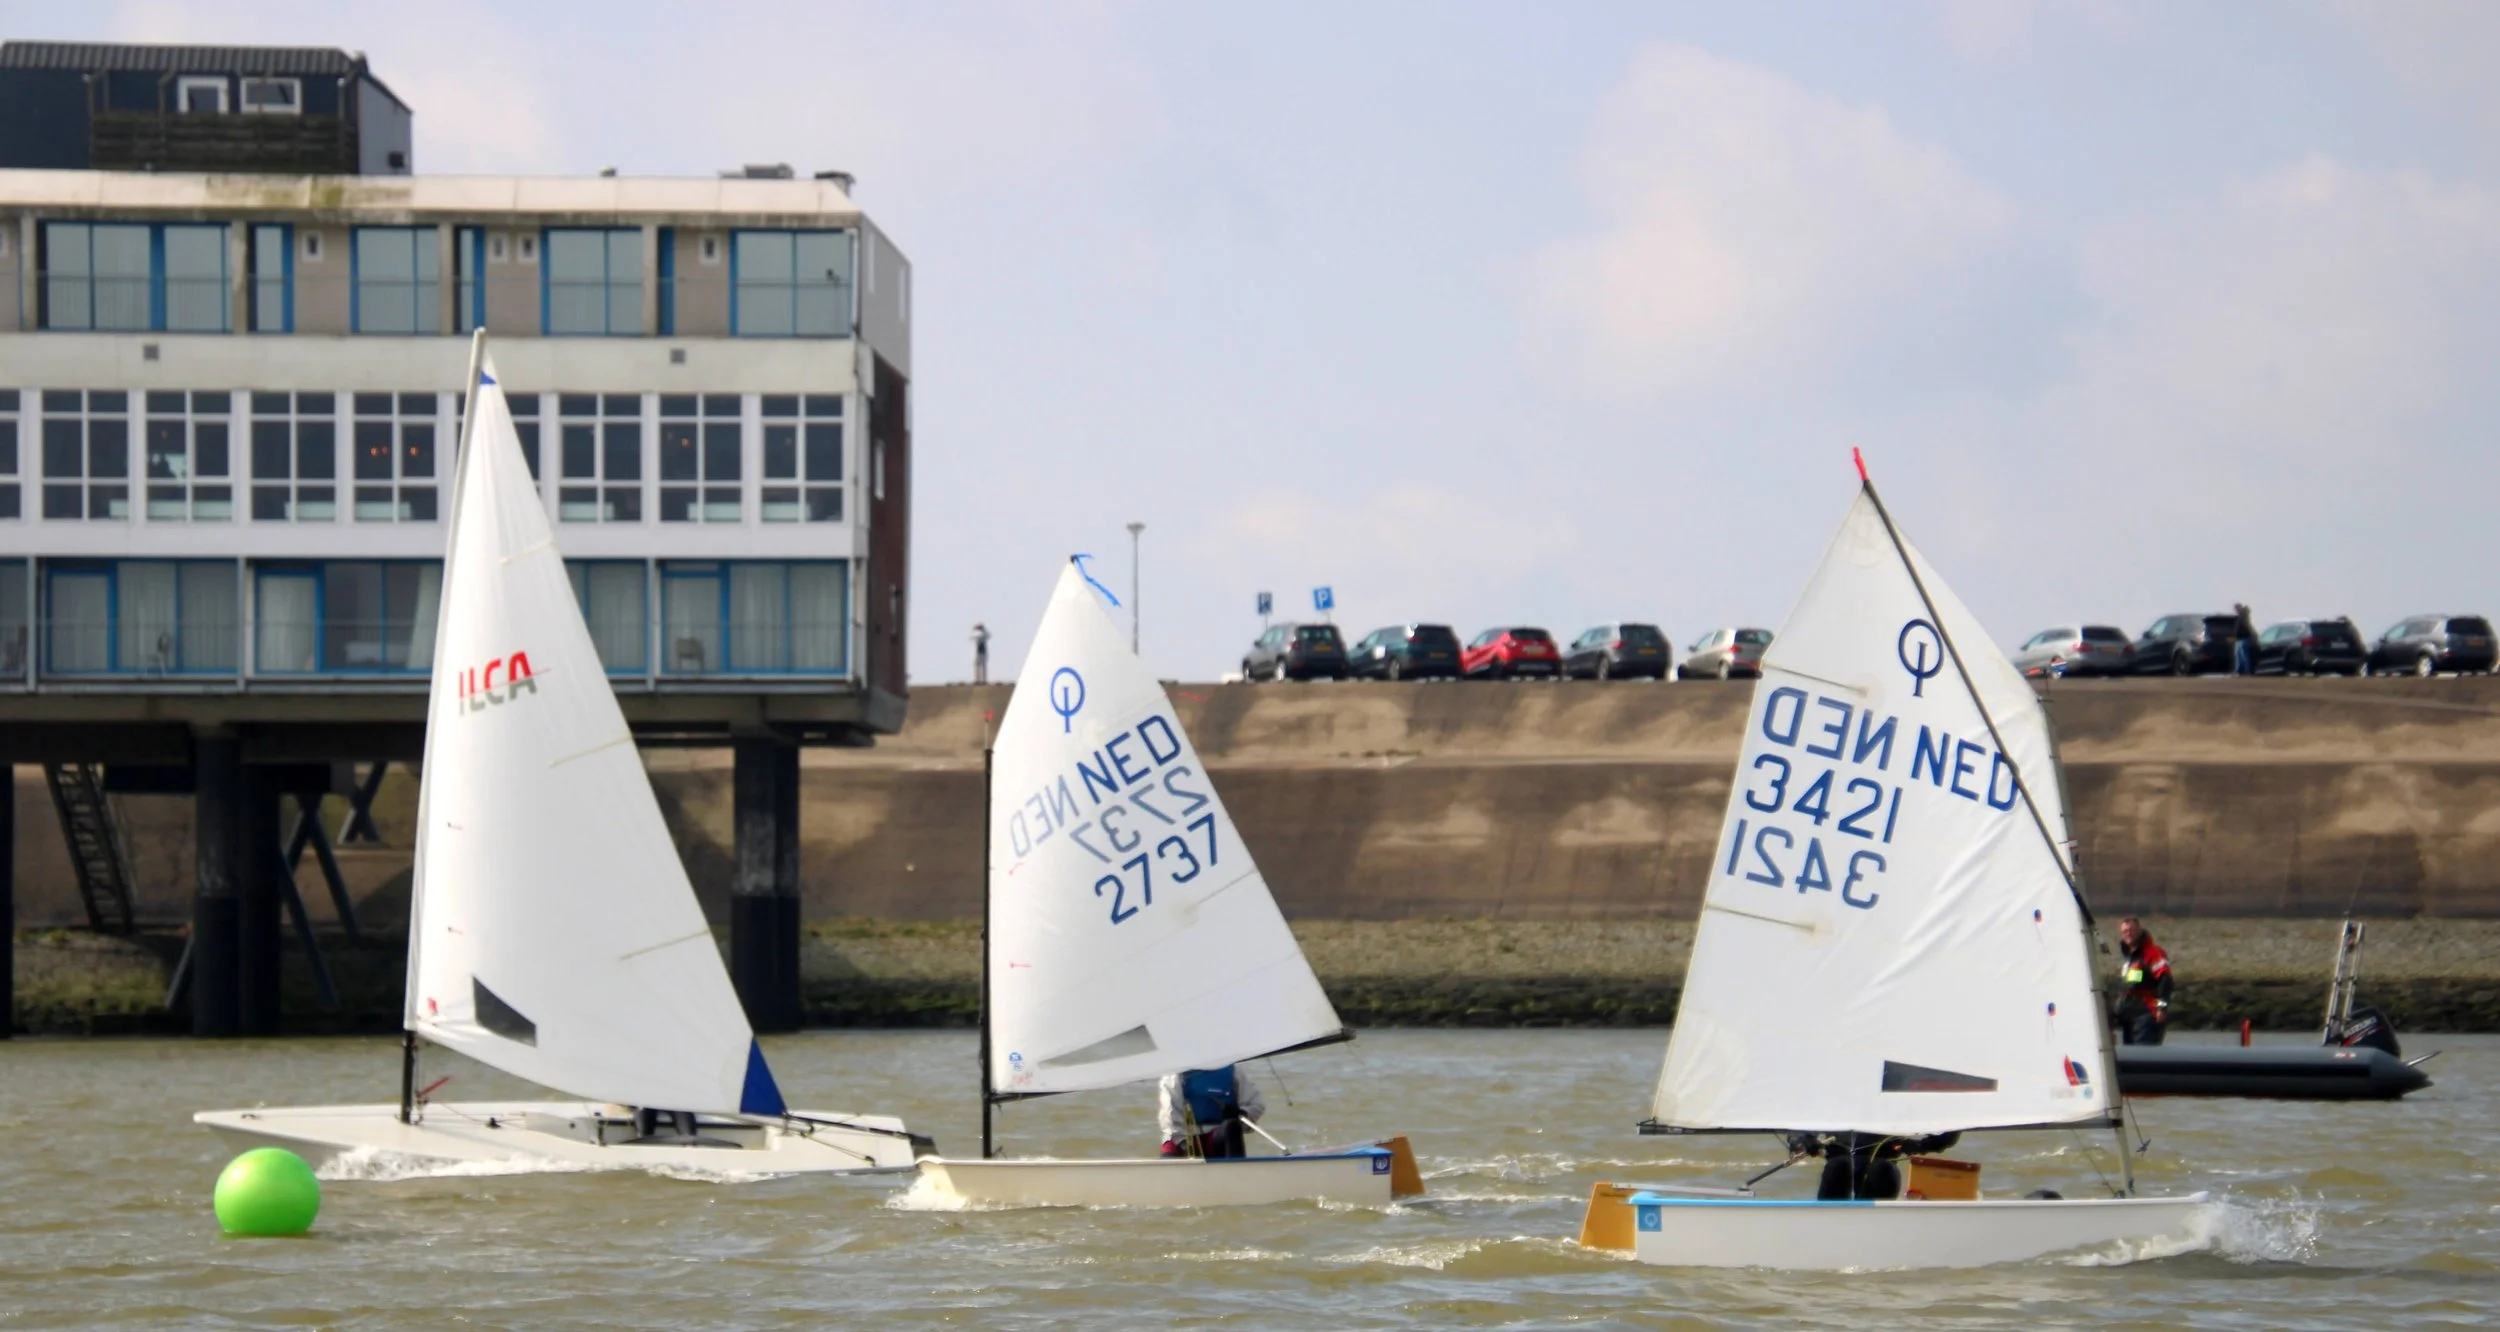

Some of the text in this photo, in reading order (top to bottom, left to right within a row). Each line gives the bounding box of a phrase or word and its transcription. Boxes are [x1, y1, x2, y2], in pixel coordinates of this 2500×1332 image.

[459, 651, 537, 716] ILCA
[1077, 715, 1181, 804] NED
[1746, 753, 1903, 844] 3421
[1911, 725, 2021, 812] NED
[1094, 812, 1218, 925] 2737
